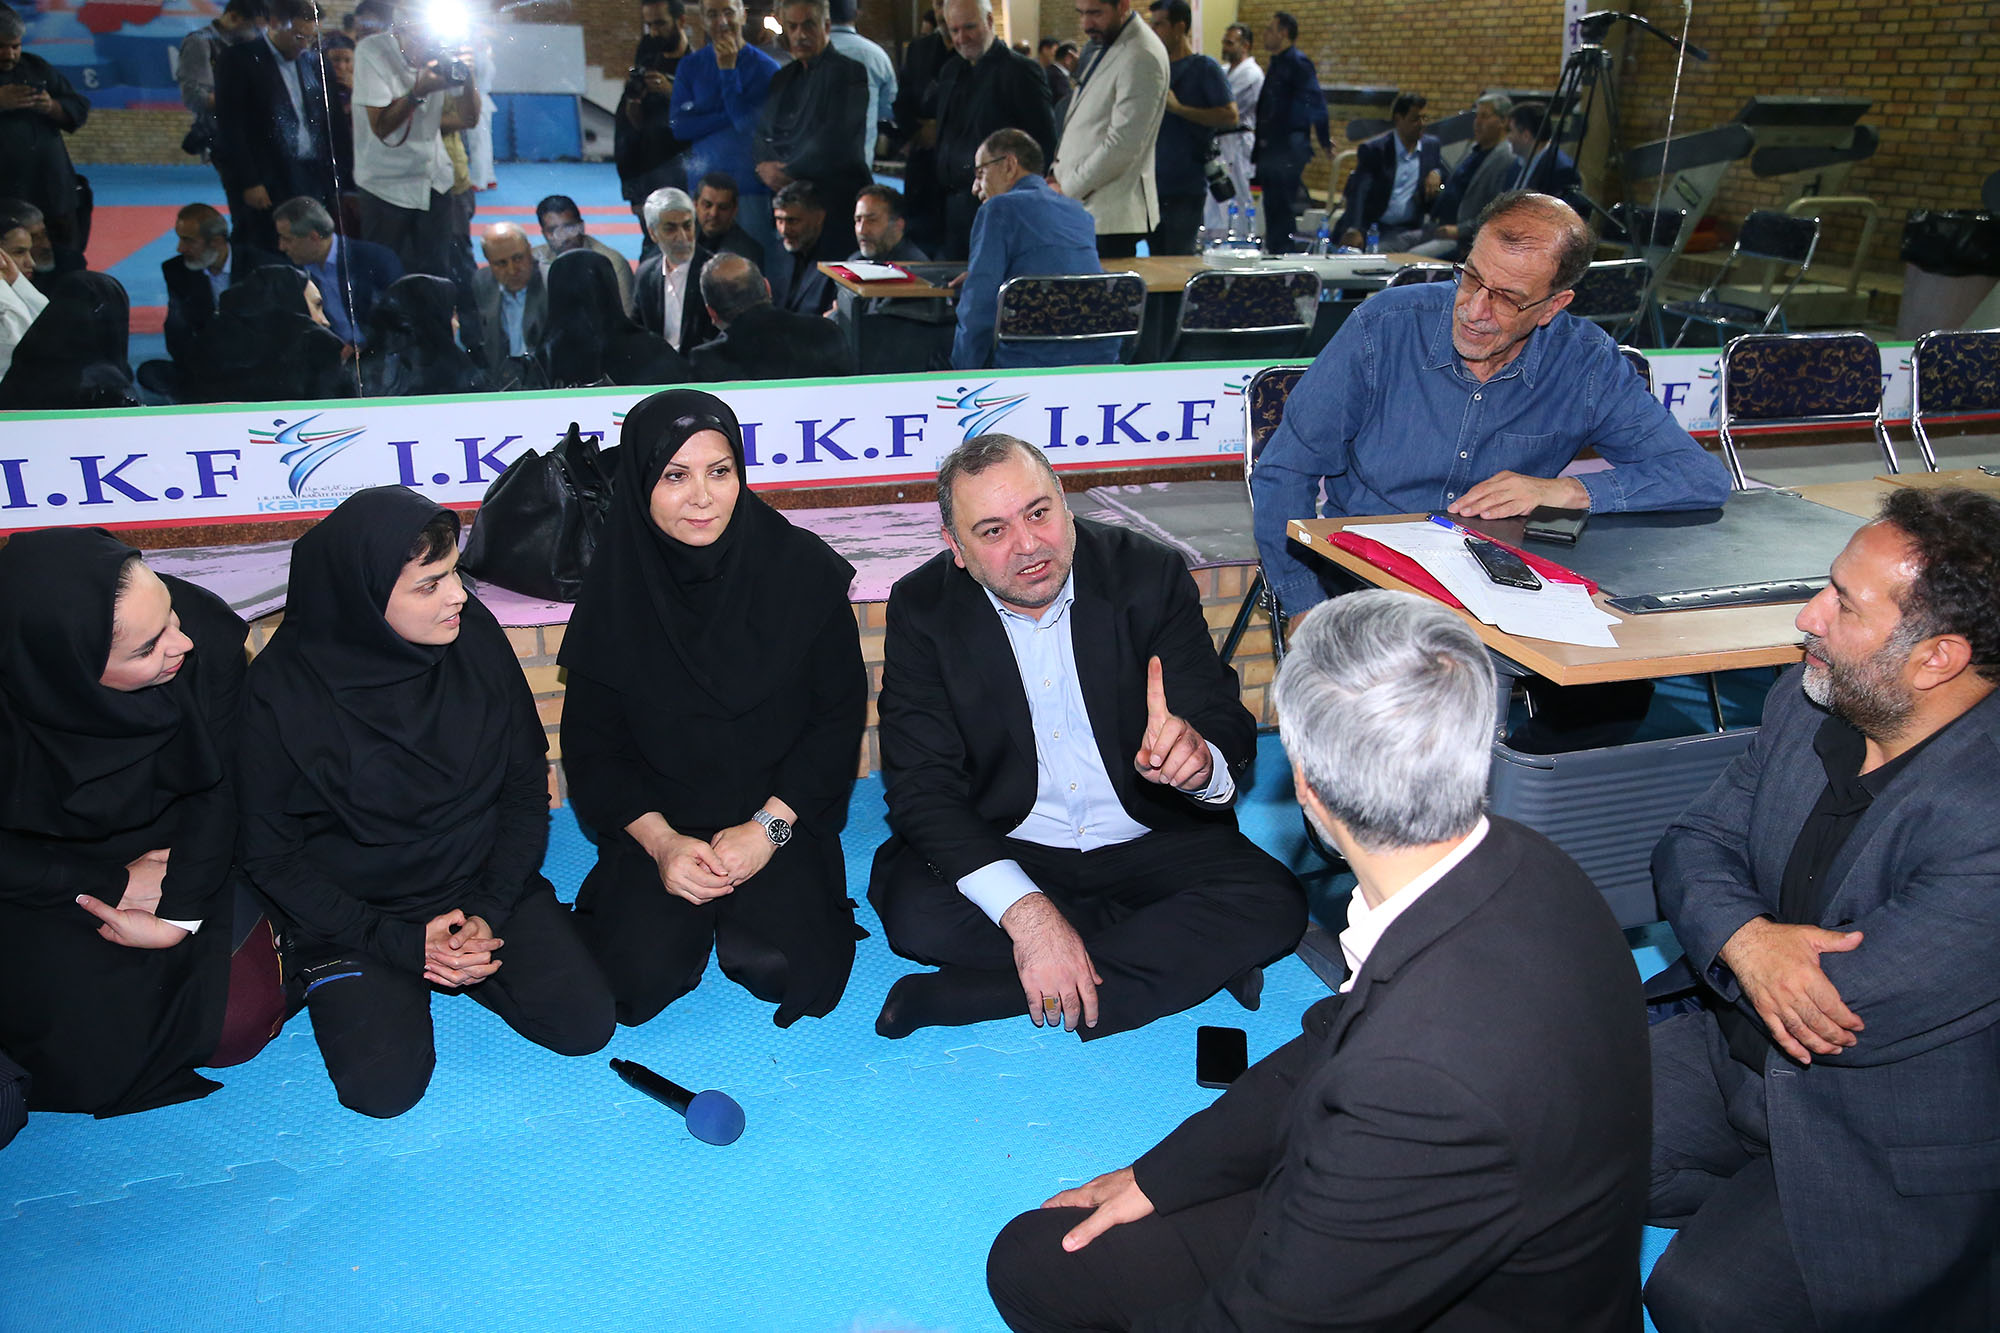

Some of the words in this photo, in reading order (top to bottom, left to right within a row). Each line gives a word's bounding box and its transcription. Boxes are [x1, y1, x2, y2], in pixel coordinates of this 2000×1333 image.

[738, 413, 929, 467] I.K.F
[1043, 399, 1216, 448] I.K.F
[0, 449, 241, 509] I.K.F
